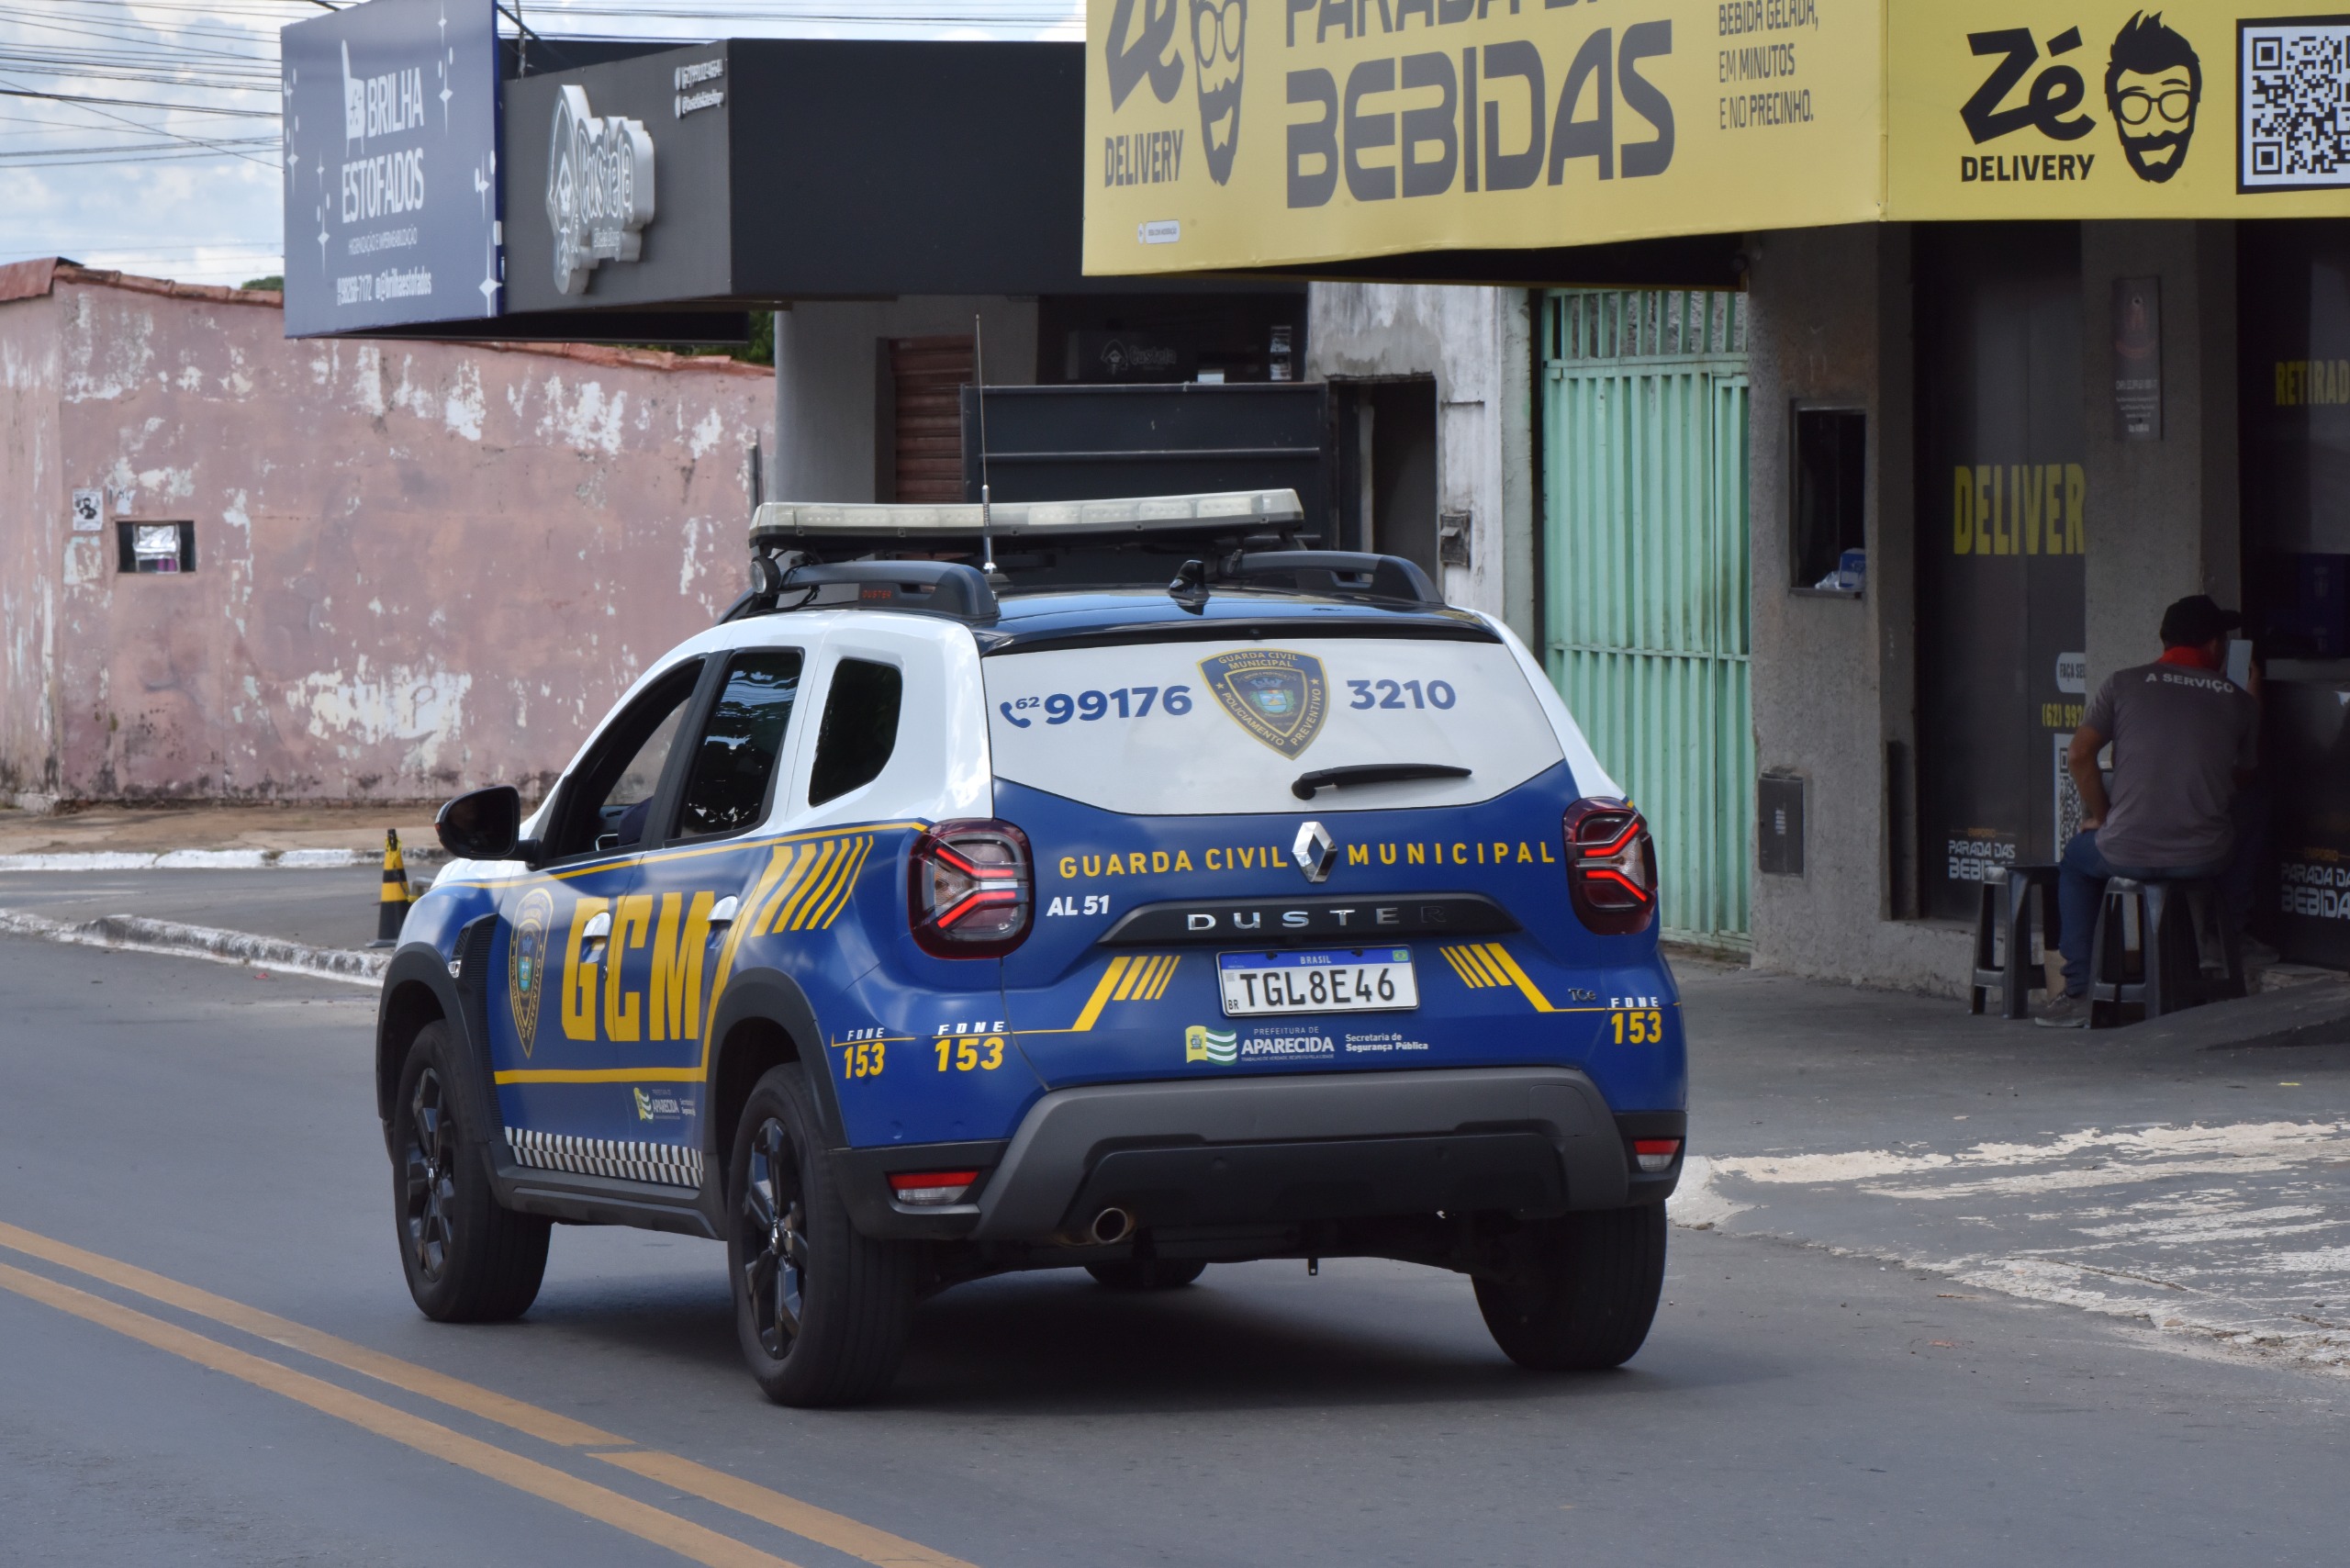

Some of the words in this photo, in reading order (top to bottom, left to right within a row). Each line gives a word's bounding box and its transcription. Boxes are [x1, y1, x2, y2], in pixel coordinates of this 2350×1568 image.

[1718, 0, 1763, 36] BEBIDA
[1719, 50, 1736, 83] EM
[1740, 42, 1795, 81] MINUTOS
[1959, 25, 2097, 145] Zé
[367, 67, 424, 138] BRILHA
[1286, 18, 1675, 209] BEBIDAS
[1719, 97, 1727, 129] E
[1729, 95, 1746, 129] NO
[1750, 89, 1814, 127] PRECINHO.
[1104, 129, 1183, 188] DELIVERY
[1961, 154, 2095, 183] DELIVERY
[341, 147, 424, 223] ESTOFADOS
[1954, 463, 2085, 554] DELIVER
[1218, 652, 1266, 664] GUARDA
[1268, 652, 1298, 661] CIVIL
[1227, 659, 1292, 670] MUNICIPAL
[2060, 663, 2074, 682] FAÇA
[2145, 672, 2157, 682] A
[2163, 673, 2234, 693] SERVIÇO
[1015, 697, 1040, 710] 62
[1044, 685, 1192, 725] 99176
[1347, 679, 1456, 710] 3210
[2042, 703, 2062, 727] (62)
[1222, 692, 1284, 745] POLICIAMENTO
[1290, 689, 1322, 745] PREVENTIVO
[1059, 850, 1192, 879] GUARDA
[1205, 846, 1288, 870] CIVIL
[1348, 842, 1555, 866] MUNICIPAL
[1948, 839, 1991, 857] PARADA
[1994, 842, 2016, 859] DAS
[2281, 861, 2333, 887] PARADA
[1046, 897, 1078, 916] AL
[1083, 895, 1110, 914] 51
[1188, 906, 1447, 931] DUSTER
[562, 890, 715, 1042] GCM
[1300, 956, 1331, 964] BRASIL
[1240, 968, 1394, 1007] TGL8E46
[1568, 989, 1596, 1001] TCe
[1228, 1000, 1239, 1010] BR
[1610, 997, 1659, 1008] FONE
[847, 1027, 884, 1041] FONE
[938, 1021, 1004, 1036] FONE
[1254, 1027, 1305, 1036] PREFEITURA
[1346, 1034, 1389, 1042] Secretaria
[1611, 1011, 1662, 1044] 153
[934, 1037, 1004, 1071] 153
[1241, 1037, 1335, 1055] APARECIDA
[1346, 1043, 1393, 1053] Segurança
[1395, 1042, 1428, 1050] Pública
[845, 1043, 885, 1079] 153
